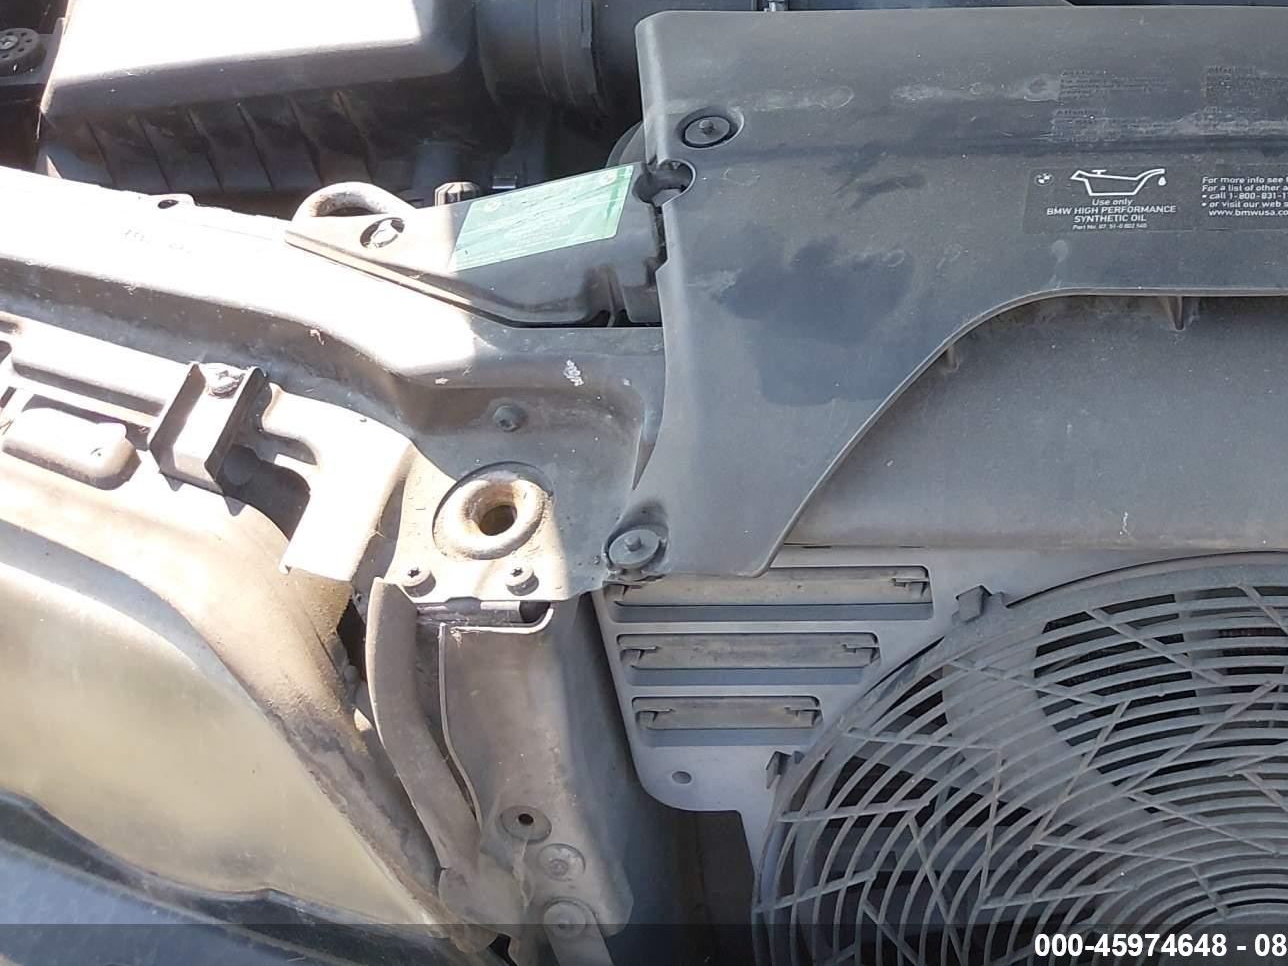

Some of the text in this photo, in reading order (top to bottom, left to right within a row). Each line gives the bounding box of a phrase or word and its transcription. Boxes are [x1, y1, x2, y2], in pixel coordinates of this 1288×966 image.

[1202, 176, 1218, 184] For
[1201, 184, 1218, 192] For
[1228, 184, 1242, 192] list
[1091, 198, 1133, 207] Use only
[1221, 200, 1241, 208] visit
[1261, 200, 1282, 208] web
[1046, 205, 1177, 216] BMW HIGH PERFORMANCE
[1073, 214, 1147, 223] SYNTHETIC OIL
